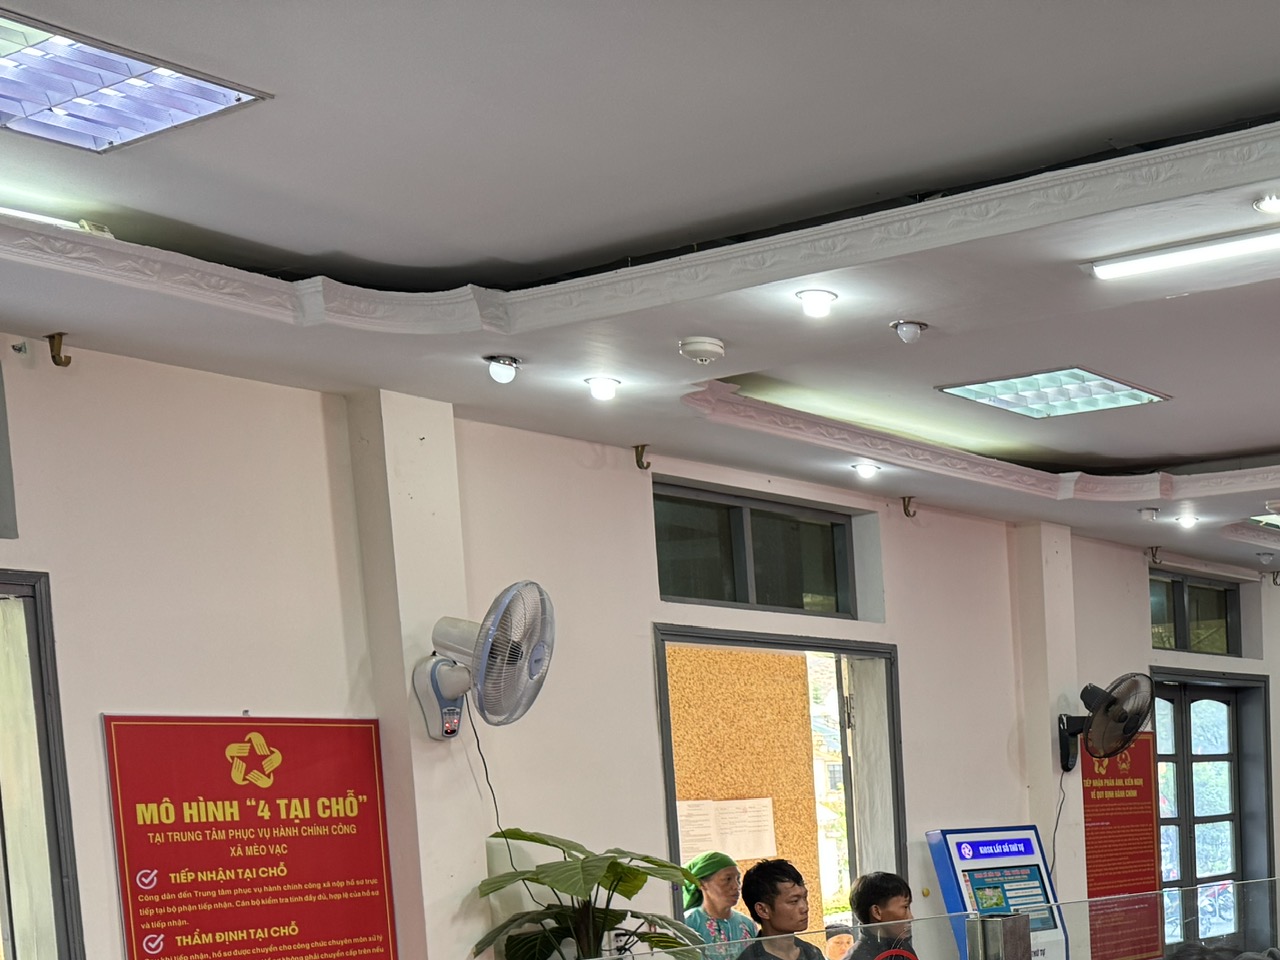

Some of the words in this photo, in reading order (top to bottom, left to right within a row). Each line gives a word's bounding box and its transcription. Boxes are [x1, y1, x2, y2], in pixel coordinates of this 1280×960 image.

[136, 797, 176, 825] MÔ
[182, 796, 240, 823] HÌNH
[276, 797, 311, 823] TẠI
[147, 832, 165, 845] TẠI
[166, 830, 202, 842] TRUNG
[204, 827, 226, 840] TÂM
[228, 828, 255, 840] PHỤC
[257, 828, 271, 839] VỤ
[272, 824, 299, 837] HÀNH
[300, 823, 329, 836] CHÍNH
[331, 822, 357, 835] CÔNG
[229, 843, 243, 856] XÃ
[245, 842, 267, 855] MÈO
[268, 843, 288, 856] VẠC
[169, 868, 195, 884] TIẾP
[197, 867, 235, 883] NHẬN
[236, 868, 256, 881] TẠI
[258, 861, 288, 877] CHỖ
[138, 894, 160, 902] Công
[161, 892, 176, 900] dân
[193, 890, 217, 898] Trung
[233, 887, 252, 896] phục
[283, 883, 302, 891] chính
[304, 882, 321, 890] công
[139, 907, 155, 916] tiếp
[155, 907, 165, 915] tại
[166, 905, 177, 913] bộ
[178, 903, 197, 913] phận
[198, 902, 212, 911] tiếp
[251, 898, 260, 906] bộ
[151, 920, 166, 929] tiếp
[175, 928, 213, 946] THẨM
[215, 930, 247, 945] ĐỊNH
[249, 928, 268, 941] TẠI
[270, 920, 299, 936] CHỖ
[278, 943, 292, 951] cho
[293, 941, 310, 950] công
